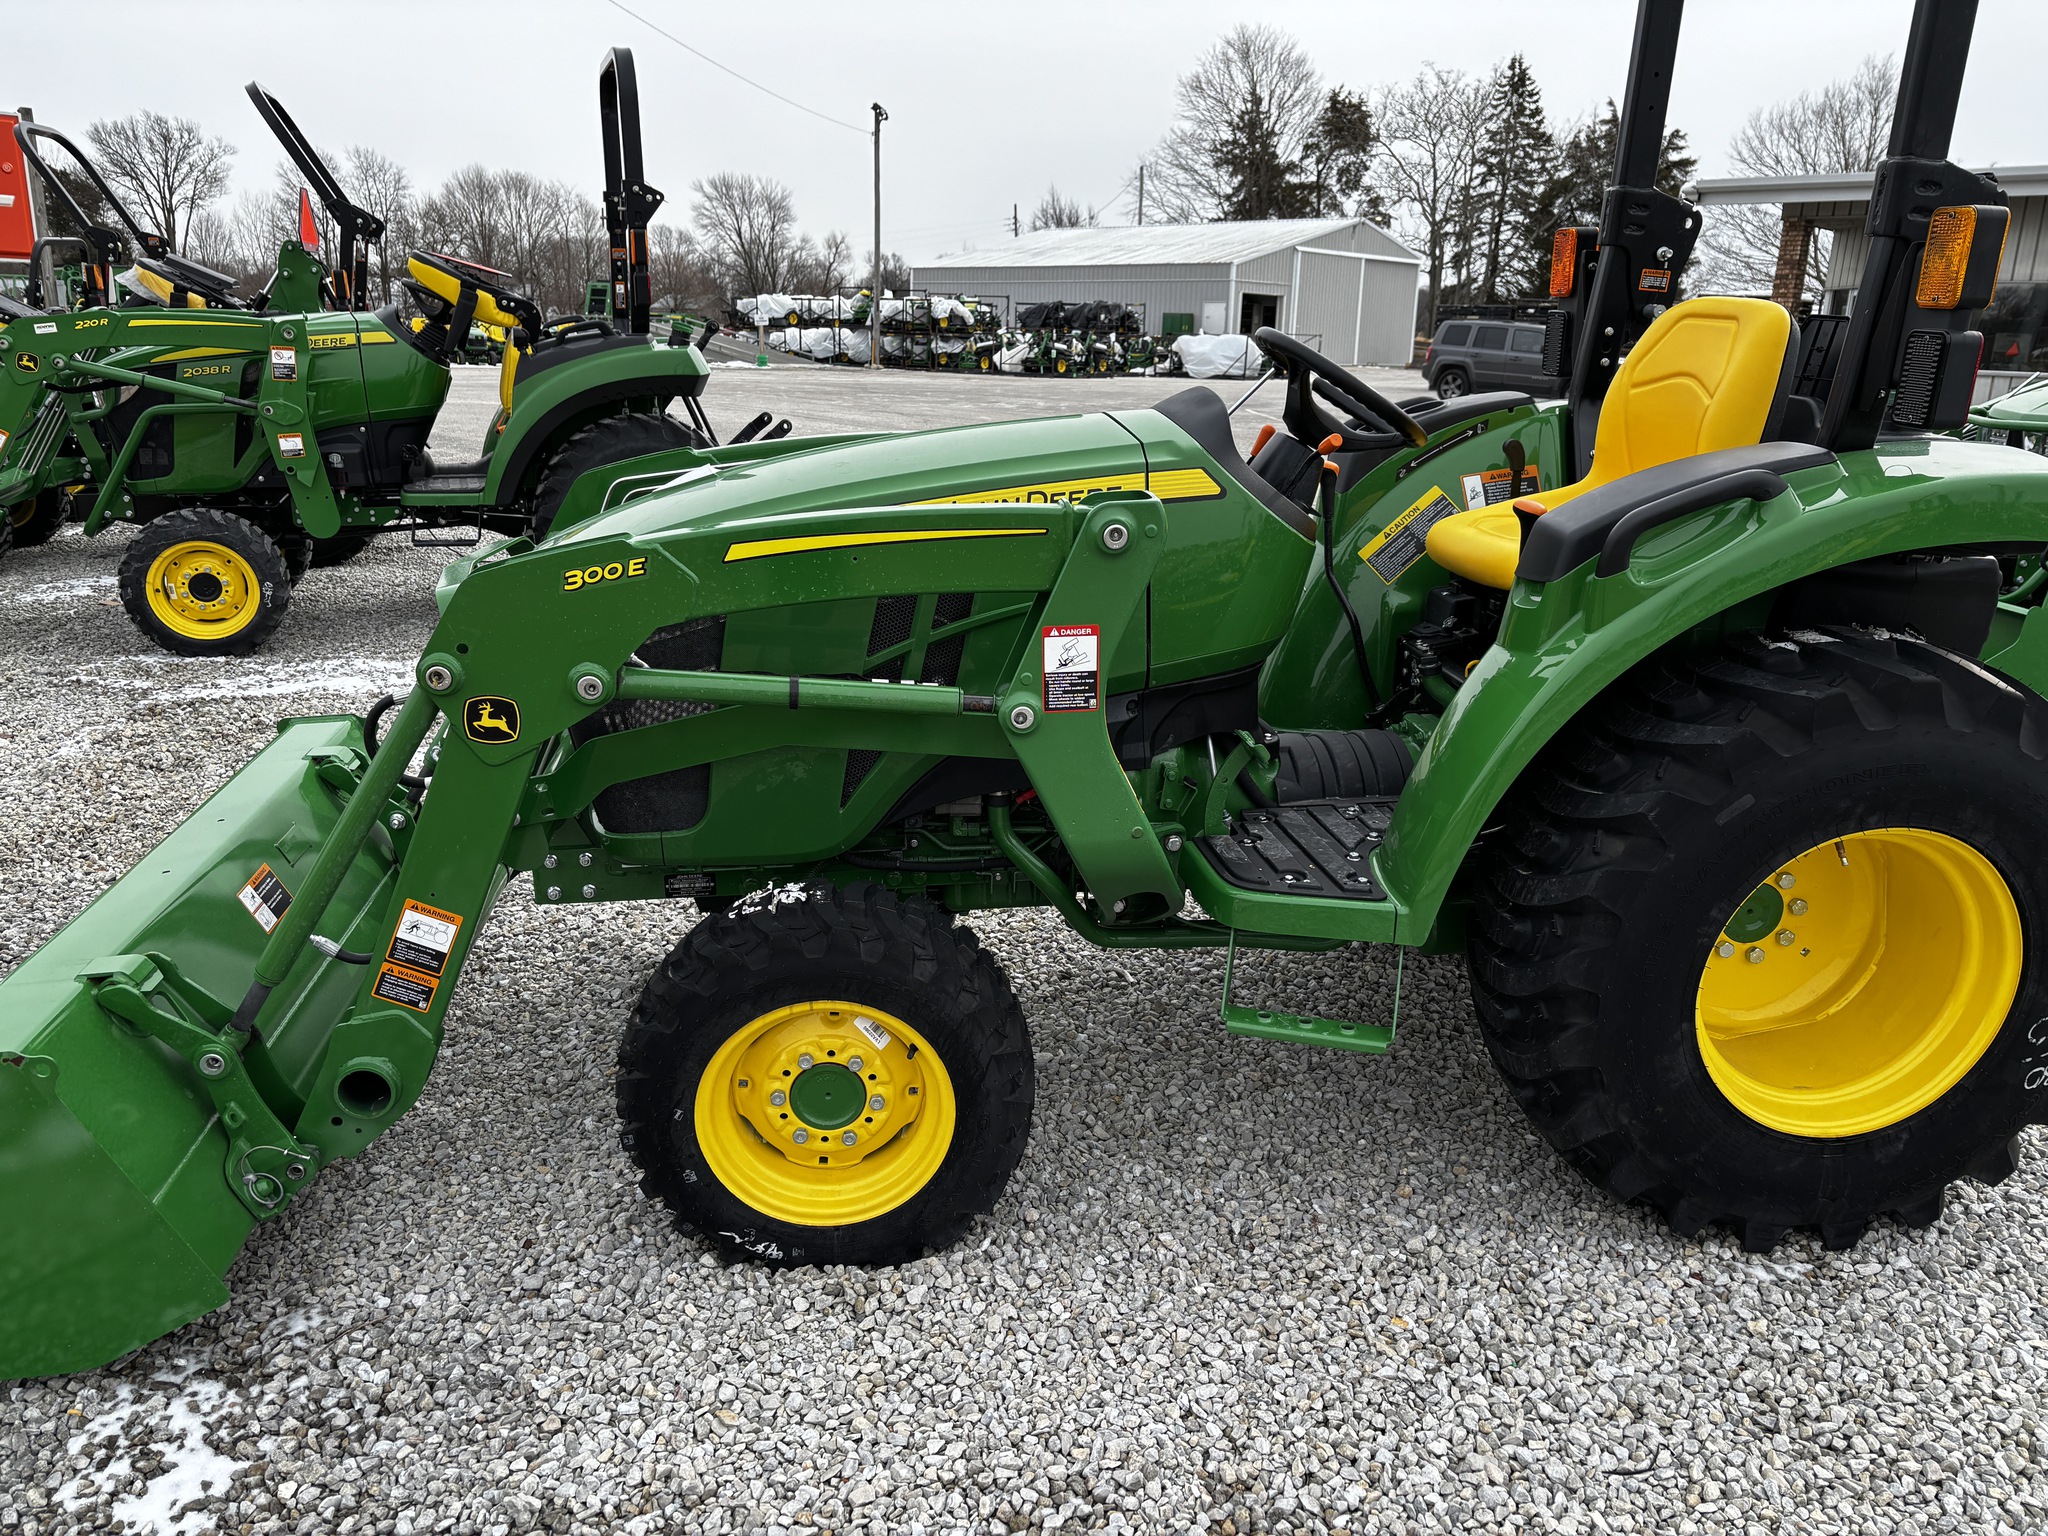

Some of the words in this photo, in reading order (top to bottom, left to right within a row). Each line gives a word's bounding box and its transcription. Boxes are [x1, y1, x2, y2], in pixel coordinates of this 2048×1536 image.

[1027, 486, 1122, 504] DEE
[1389, 505, 1420, 534] CAUTION
[563, 562, 625, 592] 300
[1060, 628, 1092, 636] DANGER
[420, 905, 456, 923] WARNING
[397, 969, 433, 986] WARNING
